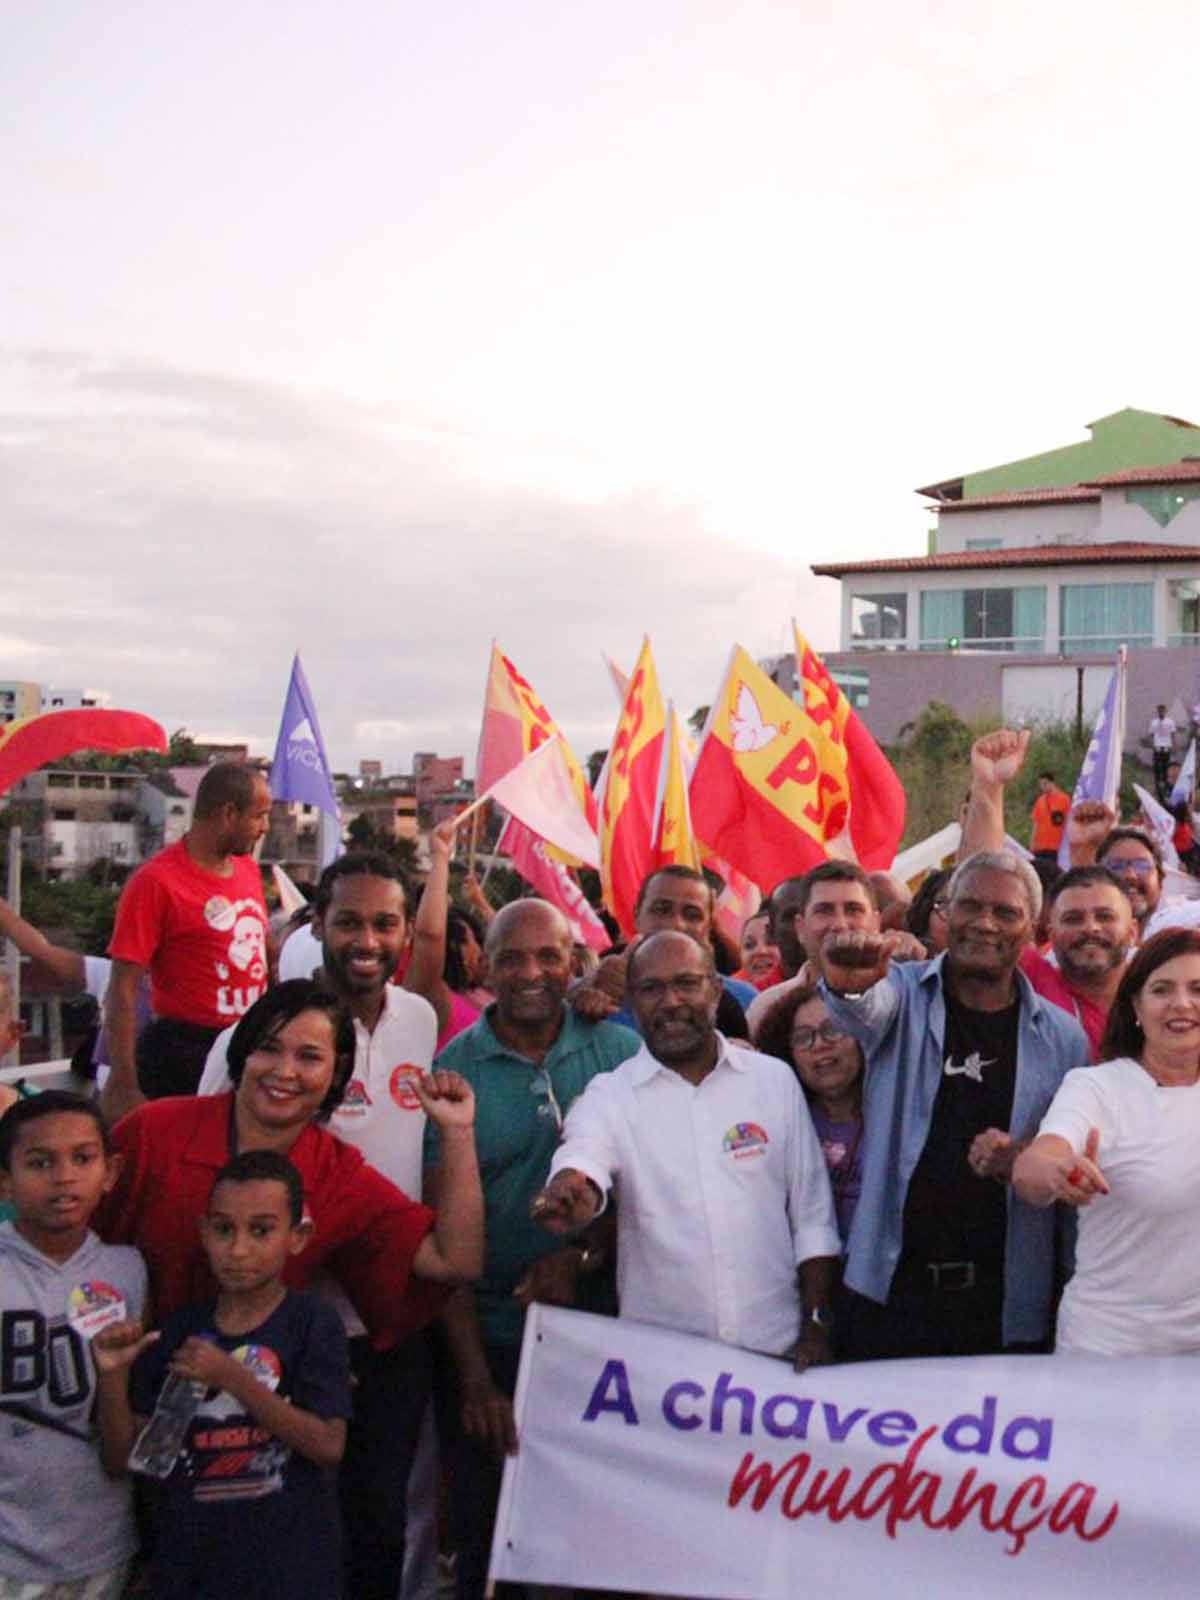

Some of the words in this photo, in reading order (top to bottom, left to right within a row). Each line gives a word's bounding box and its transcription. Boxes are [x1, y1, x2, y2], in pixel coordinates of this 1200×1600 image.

[580, 1359, 640, 1426] A
[661, 1372, 919, 1447] chave
[941, 1396, 1054, 1462] da
[727, 1425, 1120, 1556] mudança
